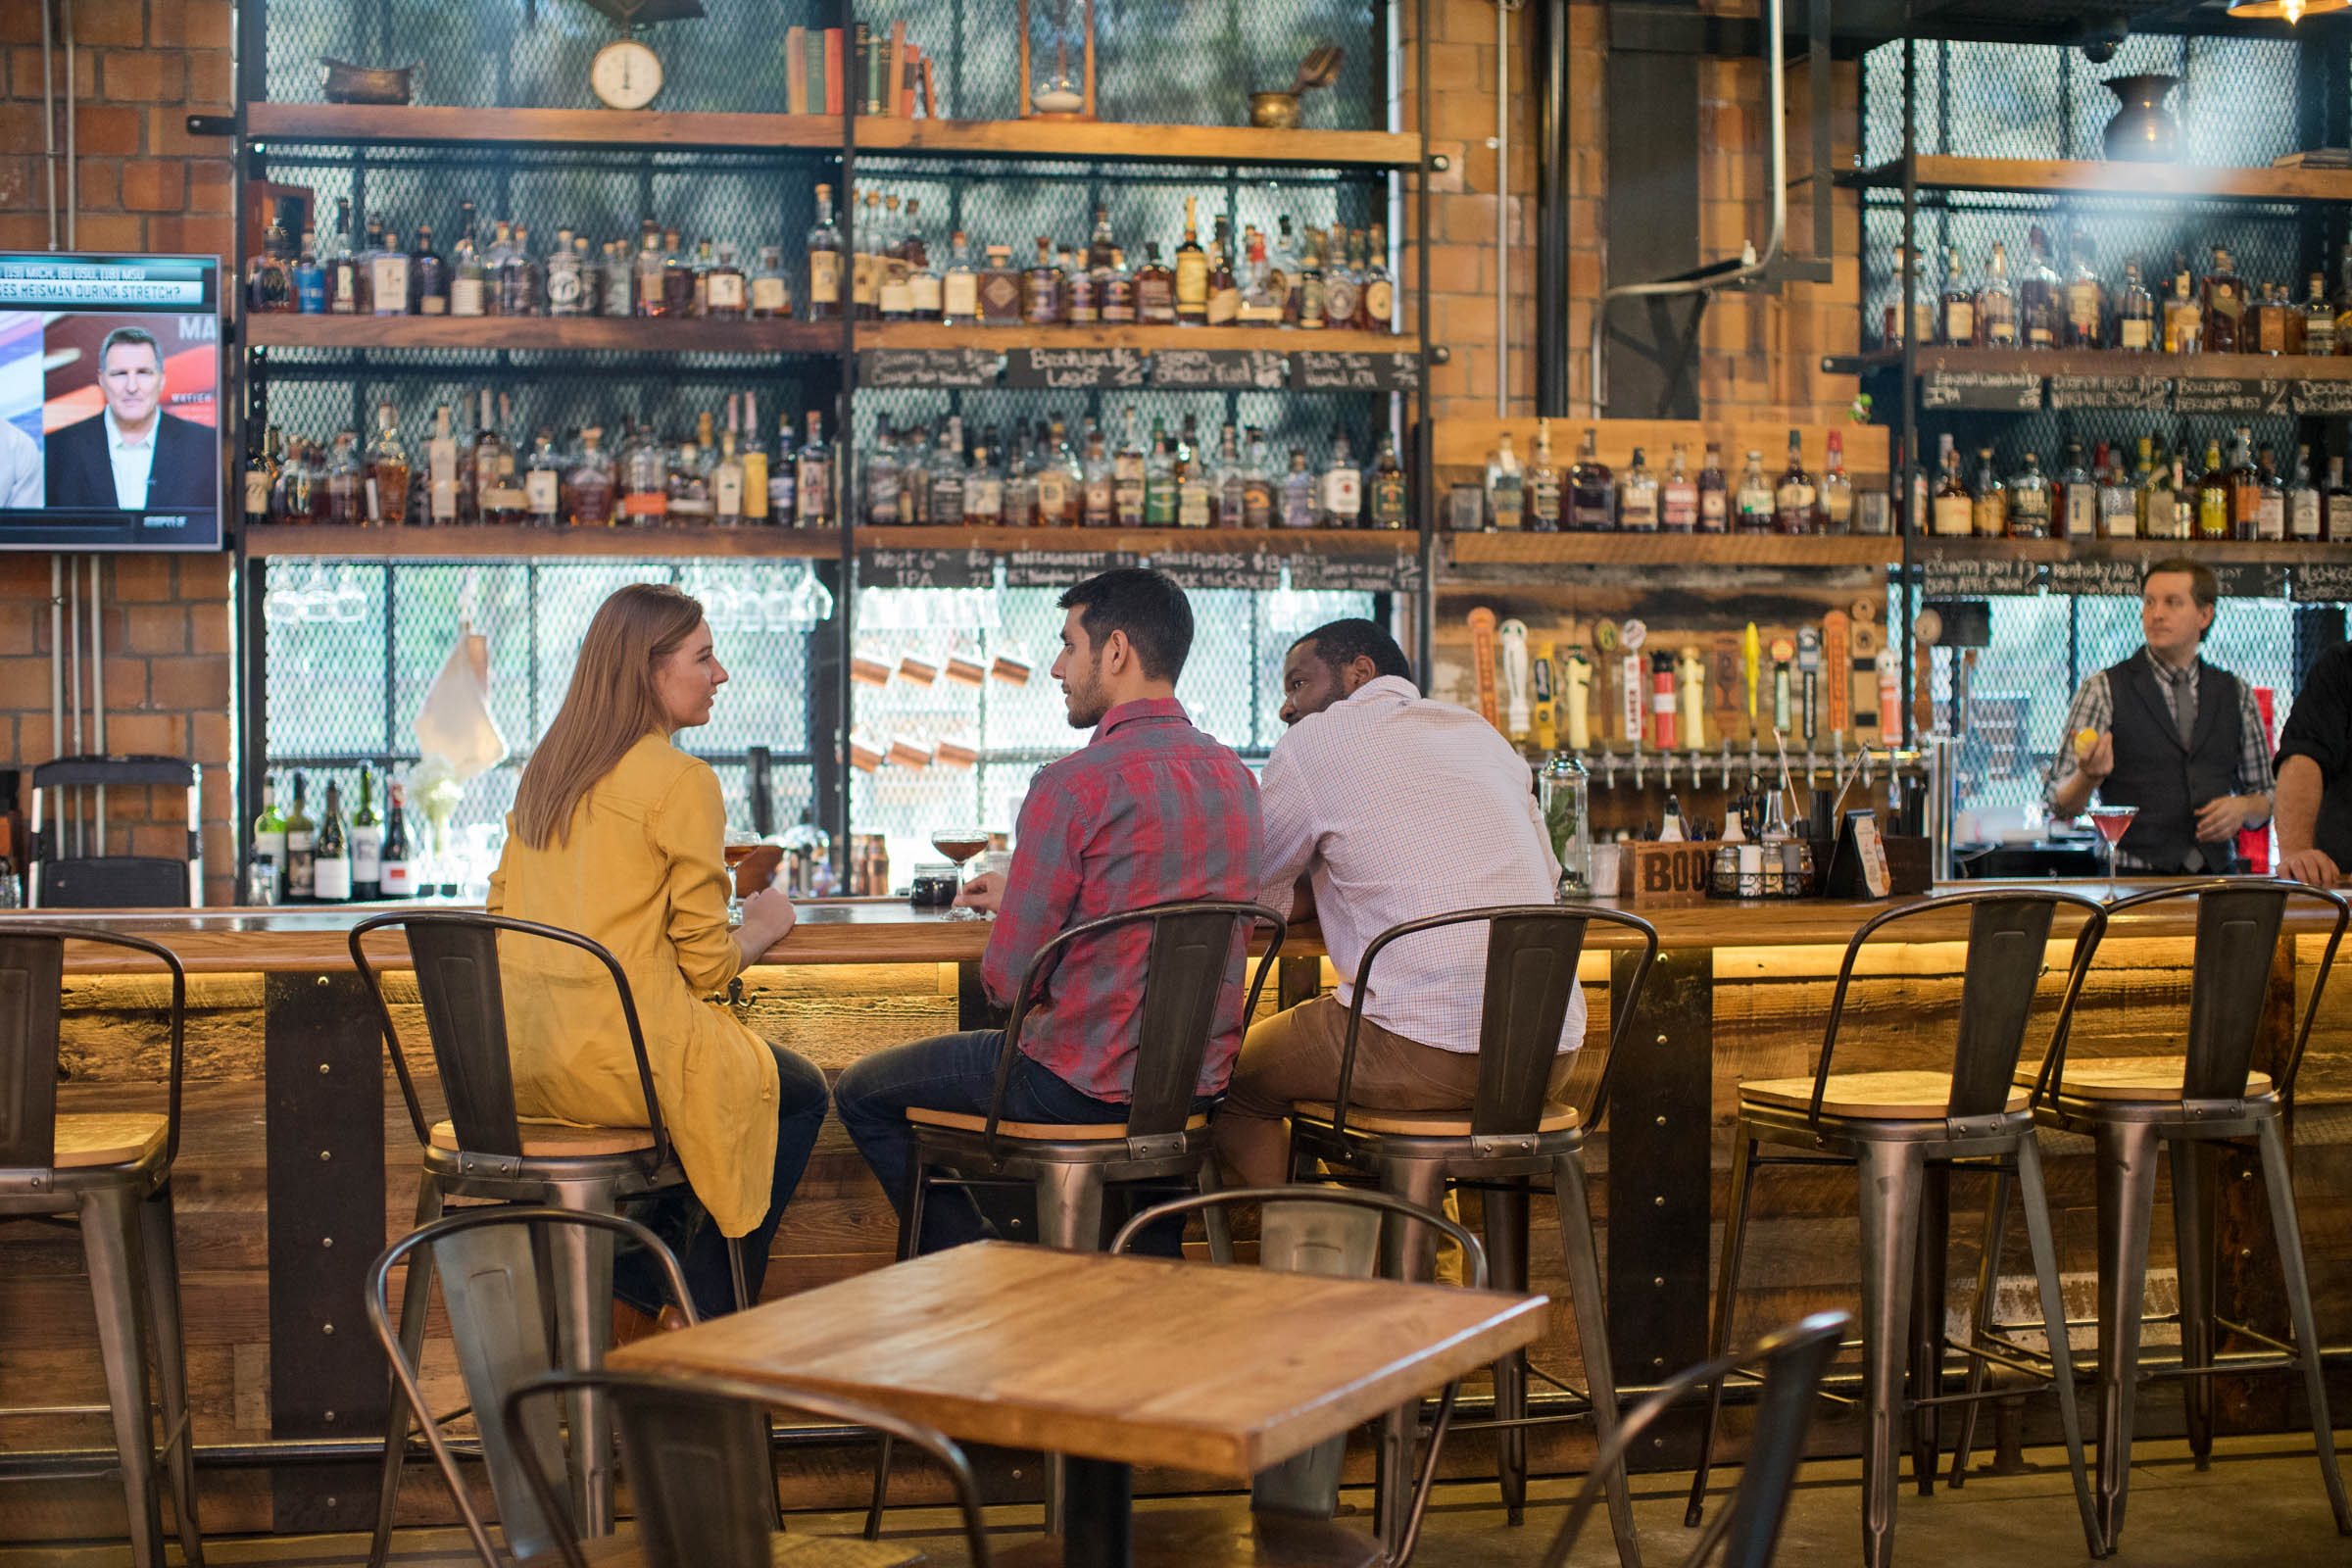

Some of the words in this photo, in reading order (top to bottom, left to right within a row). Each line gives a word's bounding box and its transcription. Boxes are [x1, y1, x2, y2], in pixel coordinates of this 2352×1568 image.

[22, 283, 72, 298] HEISMAN
[76, 284, 118, 299] DURING
[122, 285, 181, 300] STRETCH?
[1645, 850, 1714, 892] BOO
